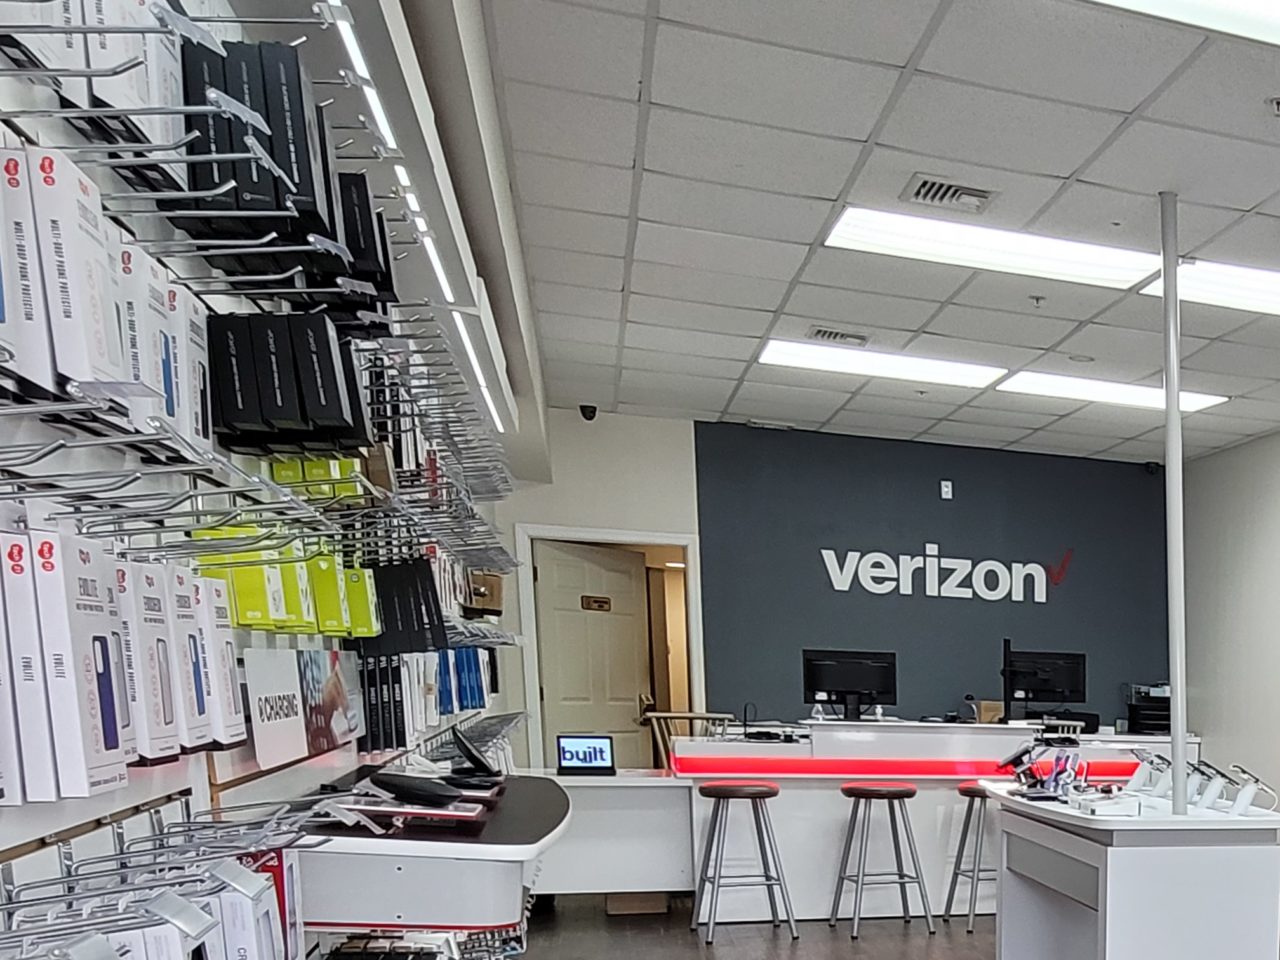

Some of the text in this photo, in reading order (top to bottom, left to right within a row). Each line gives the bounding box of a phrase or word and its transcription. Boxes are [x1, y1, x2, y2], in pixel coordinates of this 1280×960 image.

[820, 543, 1046, 603] verizon
[263, 692, 299, 722] CHARGING
[562, 746, 606, 764] built
